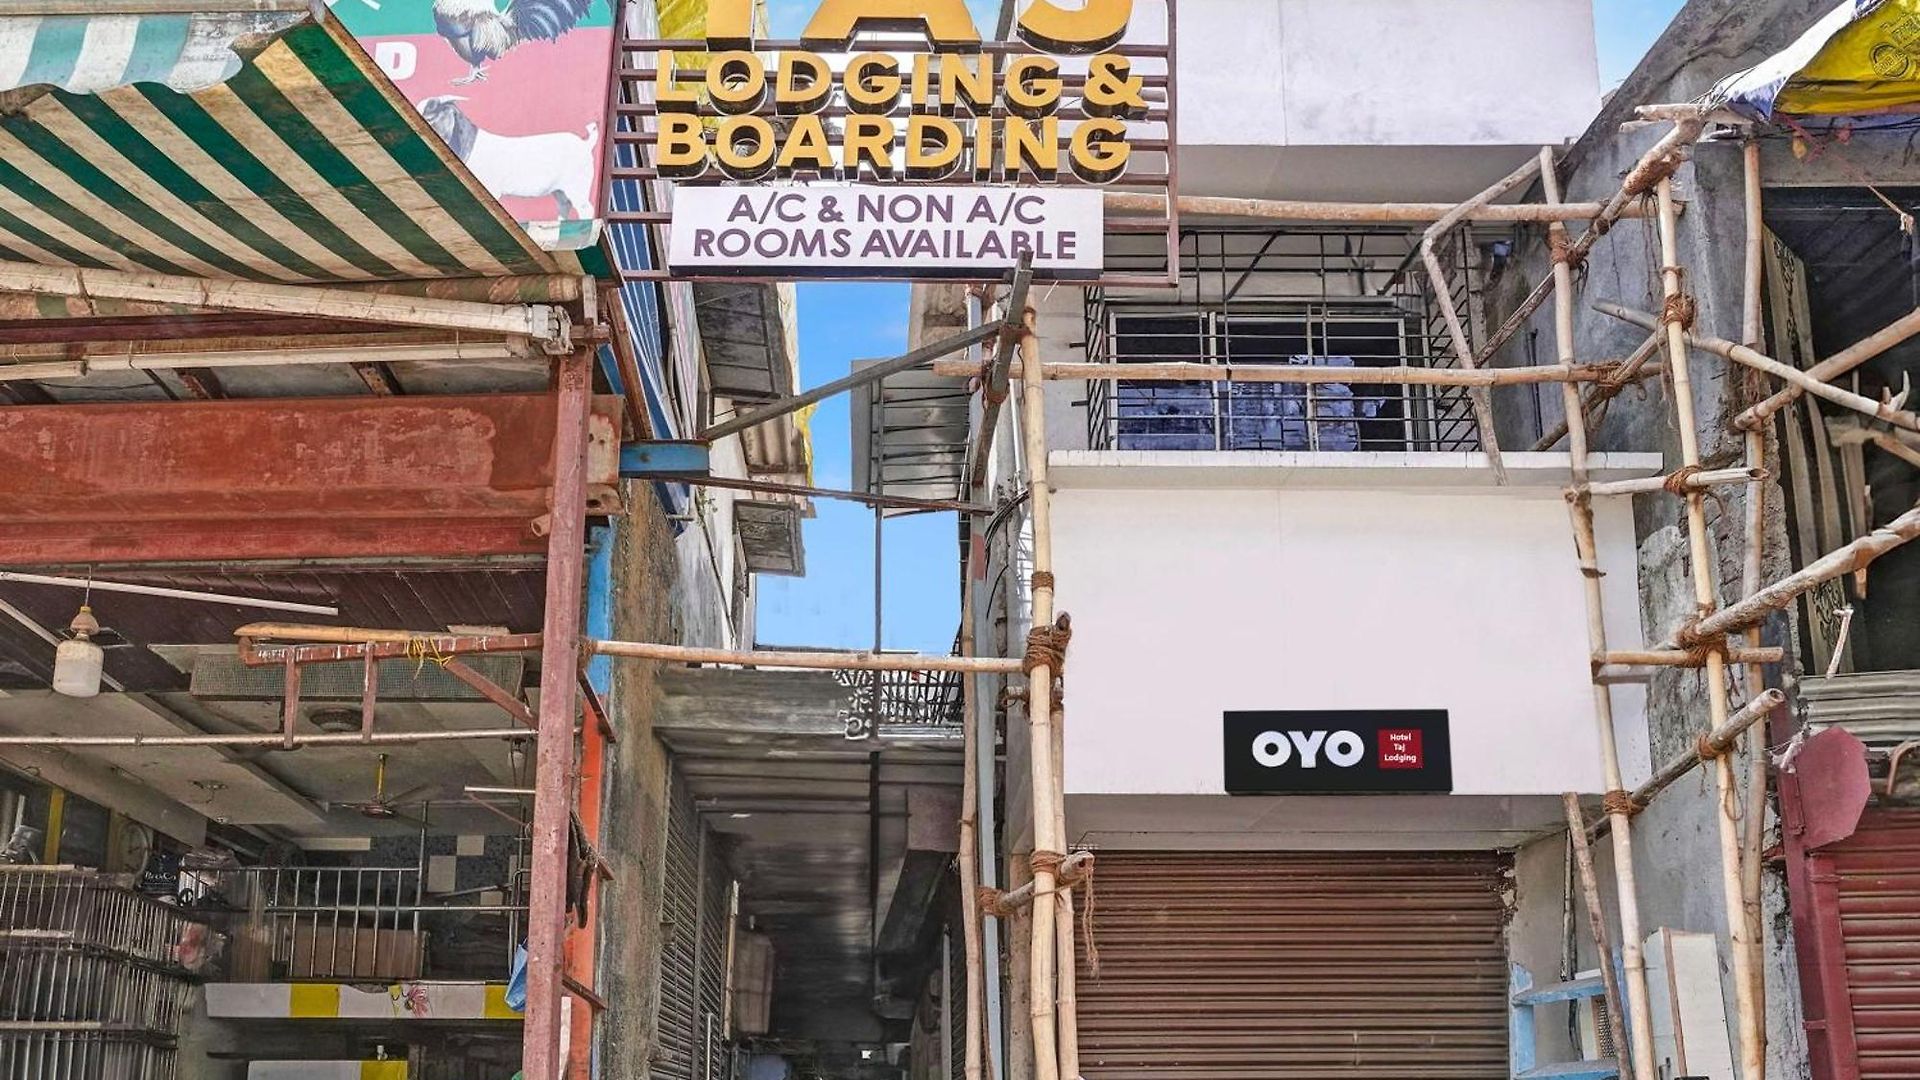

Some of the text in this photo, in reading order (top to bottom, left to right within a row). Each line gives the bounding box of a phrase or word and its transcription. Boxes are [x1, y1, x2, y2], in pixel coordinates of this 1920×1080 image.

[656, 50, 1147, 110] LODGING &
[657, 115, 1132, 172] BOARDING
[727, 193, 1046, 225] A/C & NON A/C
[693, 228, 1076, 261] ROOMS AVAILABLE
[1251, 730, 1365, 768] OYO
[1389, 733, 1412, 741] Hotel
[1393, 743, 1406, 753] Taj
[1384, 753, 1417, 763] Lodging
